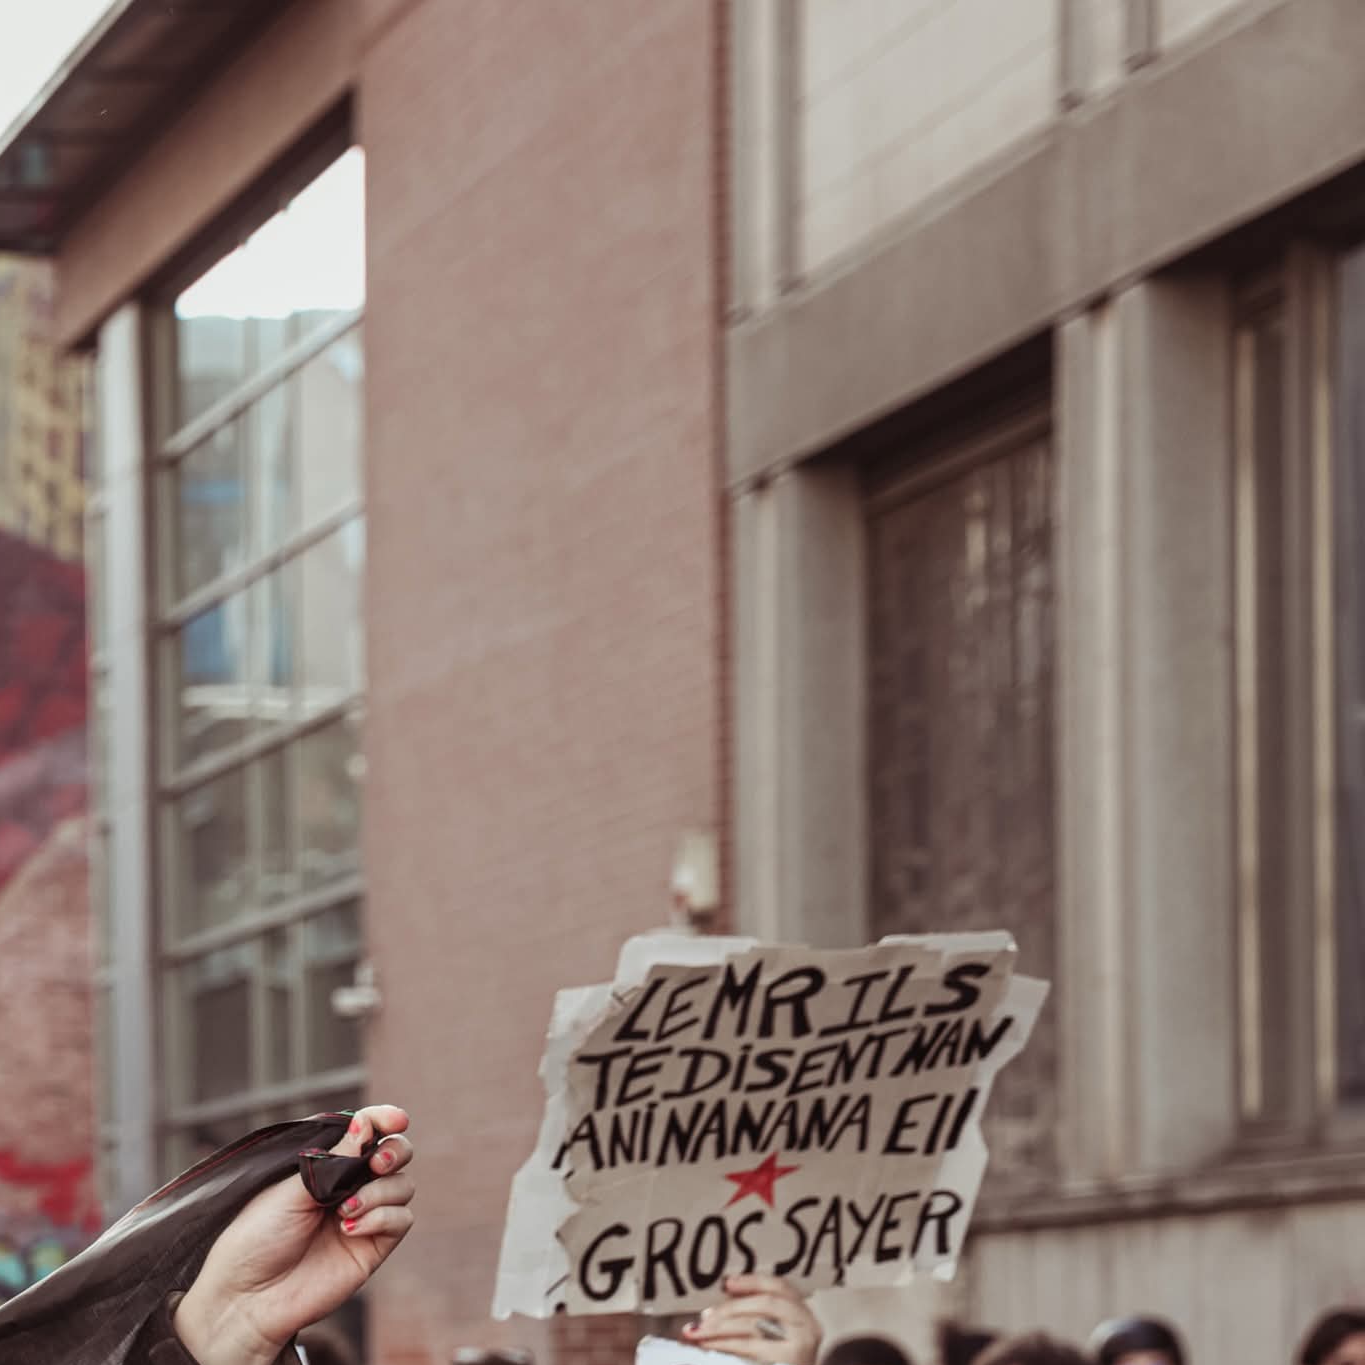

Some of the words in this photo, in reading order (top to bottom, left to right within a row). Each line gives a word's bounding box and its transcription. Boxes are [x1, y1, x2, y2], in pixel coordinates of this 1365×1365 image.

[818, 963, 992, 1036] ILS
[579, 1210, 764, 1302] GROS
[774, 1188, 963, 1286] SAYER
